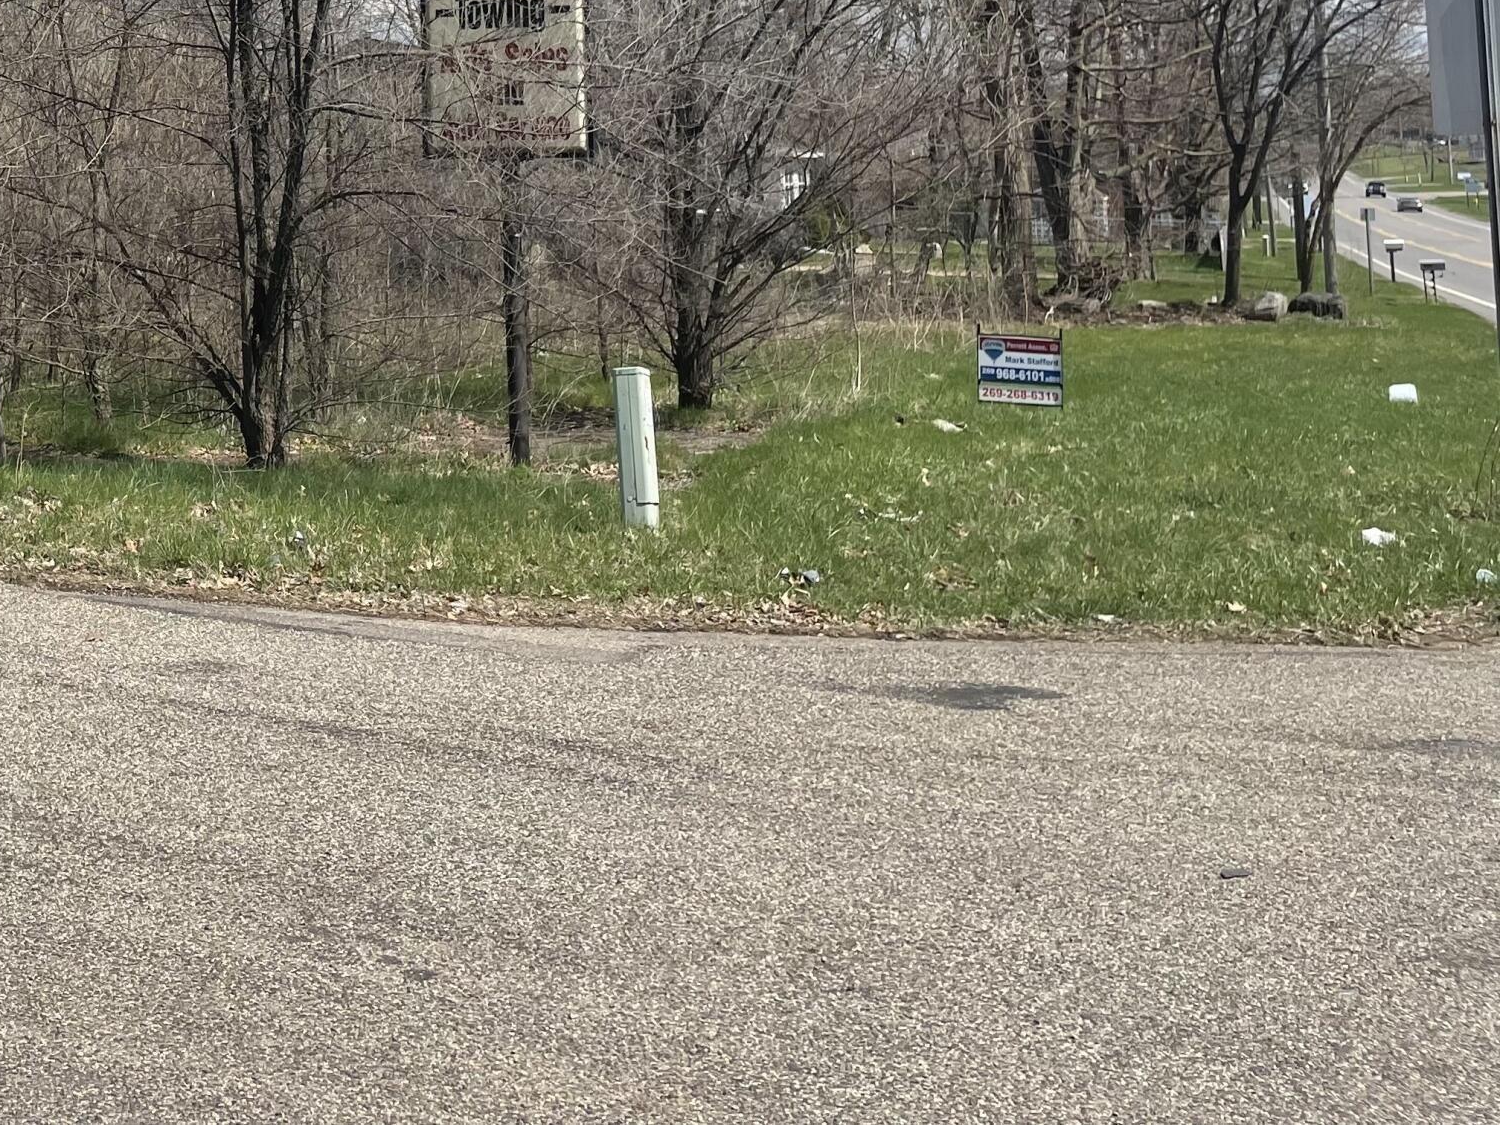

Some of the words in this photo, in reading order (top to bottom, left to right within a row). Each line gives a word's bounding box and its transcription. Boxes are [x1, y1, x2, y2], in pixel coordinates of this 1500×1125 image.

[1005, 355, 1025, 365] Mark
[1027, 357, 1059, 367] Stafford
[996, 369, 1045, 382] 968-6101
[982, 387, 1059, 402] 269-268-6319
